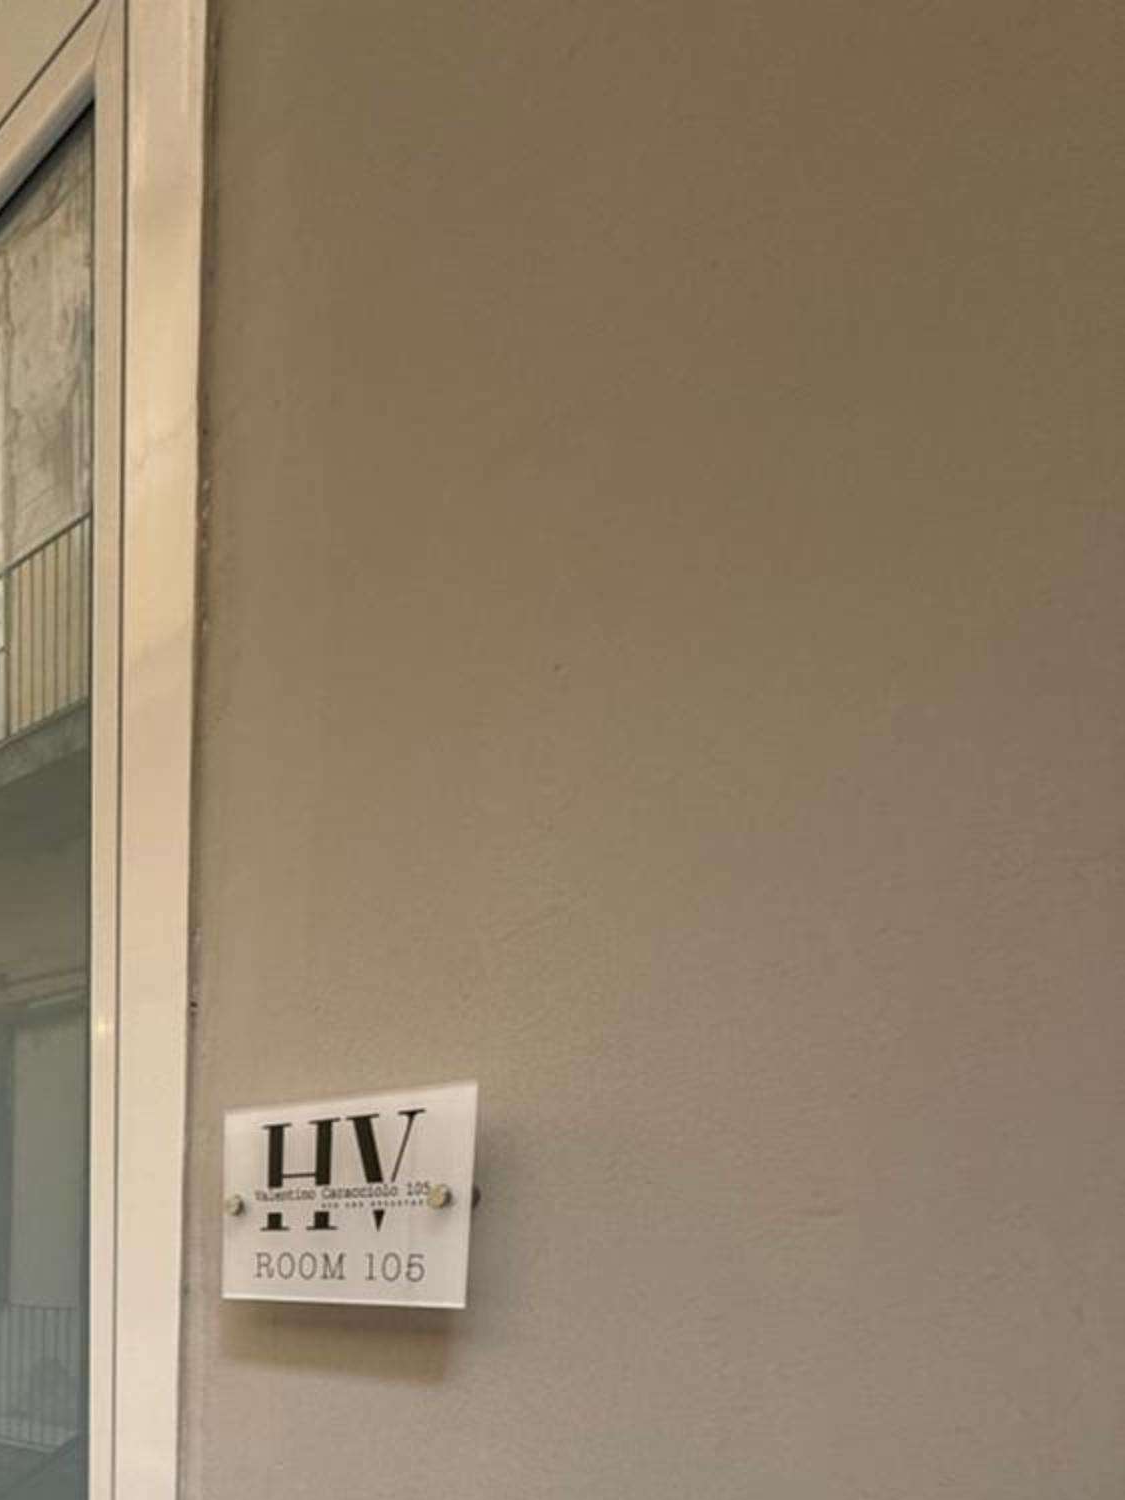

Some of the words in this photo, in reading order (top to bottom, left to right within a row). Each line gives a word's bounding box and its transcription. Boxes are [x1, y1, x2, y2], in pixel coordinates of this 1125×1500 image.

[254, 1187, 316, 1202] Valentino
[321, 1183, 398, 1200] Caracciolo
[407, 1181, 430, 1196] 105
[253, 1252, 346, 1281] ROOM
[364, 1252, 426, 1283] 105
